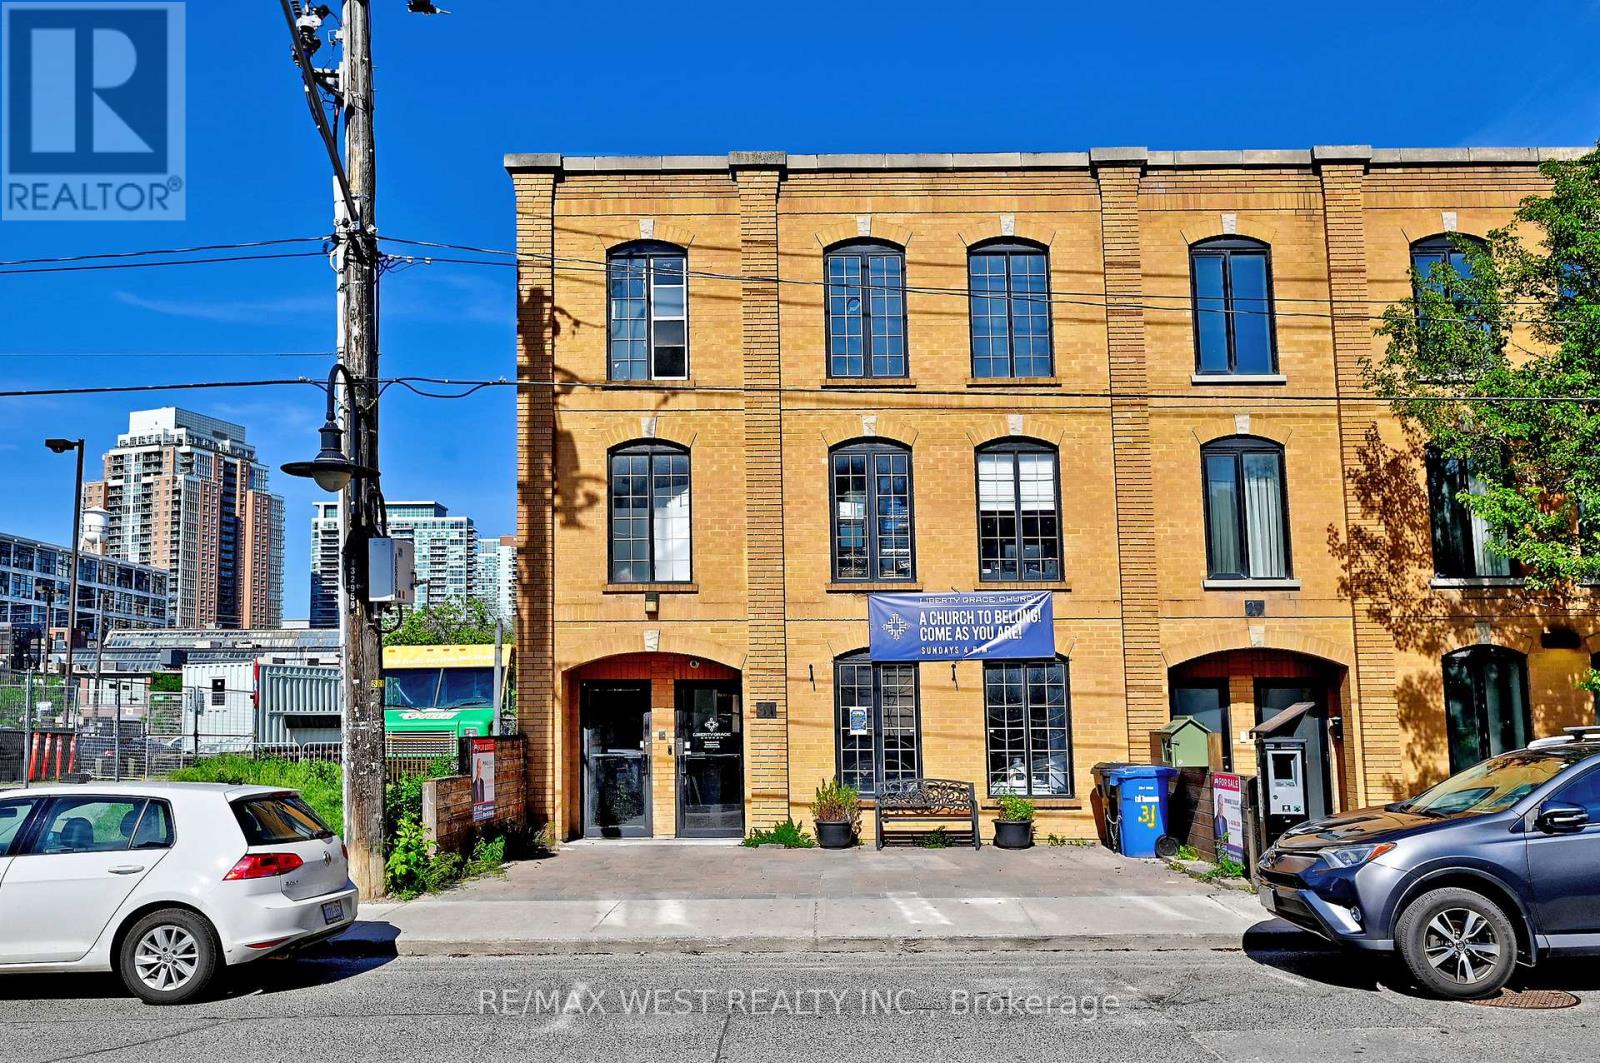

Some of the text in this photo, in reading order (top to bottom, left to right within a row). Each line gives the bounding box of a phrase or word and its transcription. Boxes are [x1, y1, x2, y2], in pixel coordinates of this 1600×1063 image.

[919, 595, 1041, 604] LIBERTY GRACE CHURCH
[919, 610, 1041, 626] A CHURCH TO BELONG!
[920, 624, 1023, 641] COME AS YOU ARE!
[920, 646, 960, 655] SUNDAYS
[1218, 777, 1239, 788] FOR SALE
